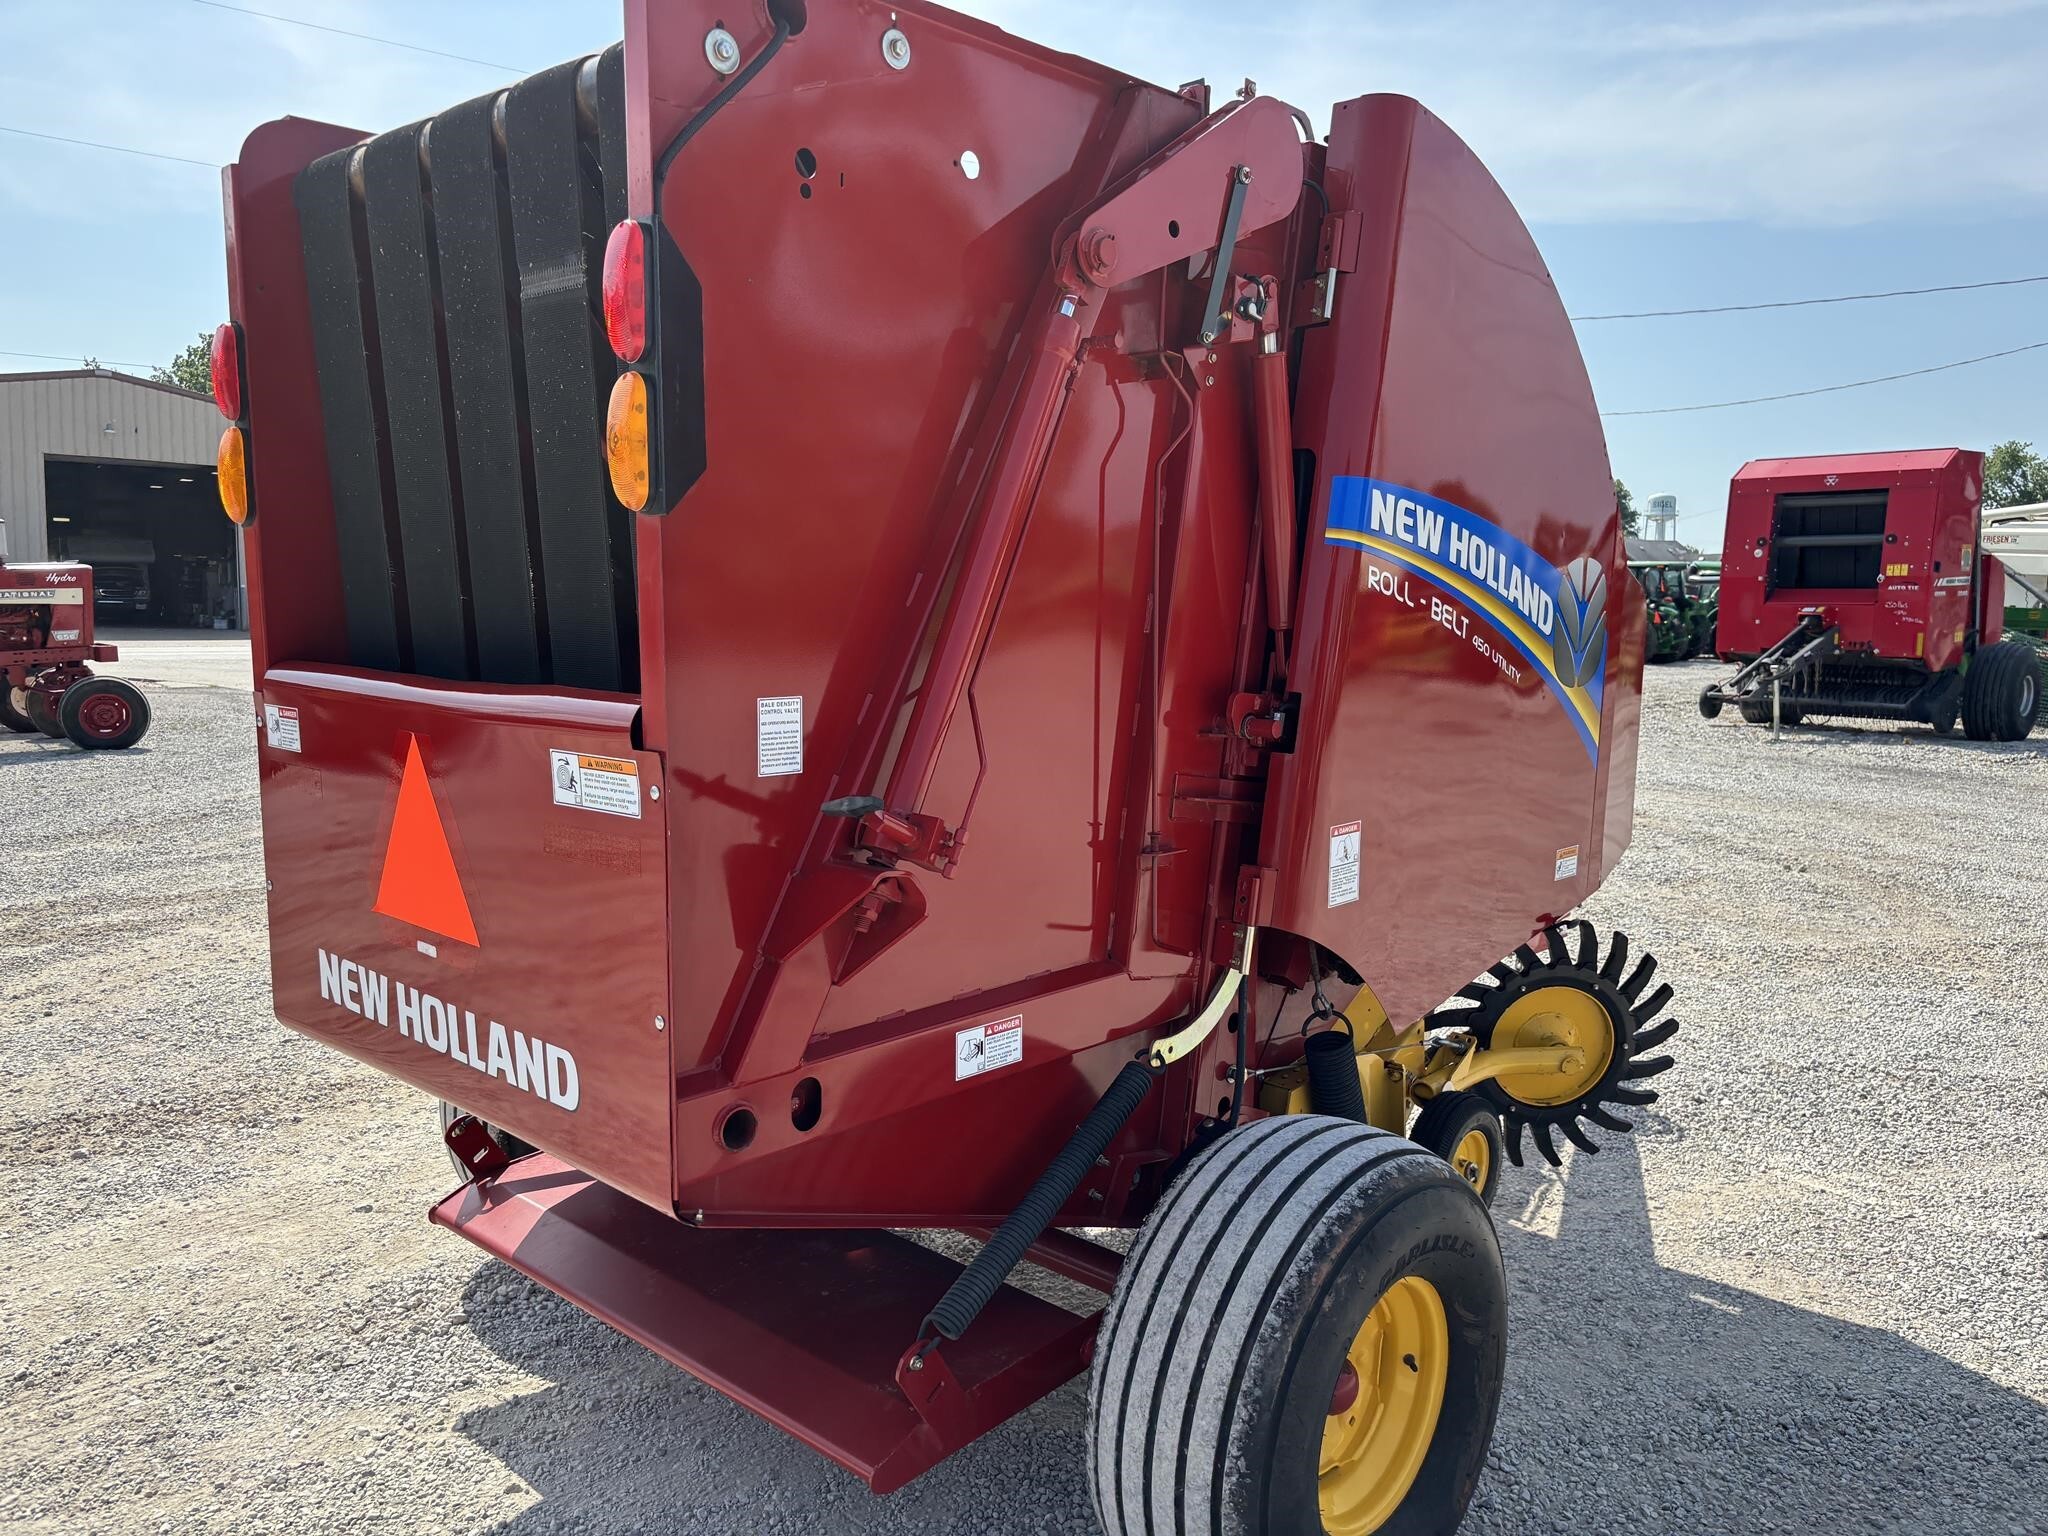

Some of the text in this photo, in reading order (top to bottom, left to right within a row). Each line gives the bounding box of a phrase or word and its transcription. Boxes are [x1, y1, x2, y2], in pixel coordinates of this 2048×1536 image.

[45, 573, 76, 584] Hydro
[1371, 488, 1554, 636] NEW HOLLAND
[1368, 565, 1415, 607] ROLL
[1431, 598, 1469, 639] BELT
[1472, 635, 1490, 657] 450
[1491, 651, 1521, 684] UTILITY
[595, 760, 623, 771] WARNING
[318, 948, 580, 1112] NEW HOLLAND
[994, 1019, 1020, 1032] DANGER
